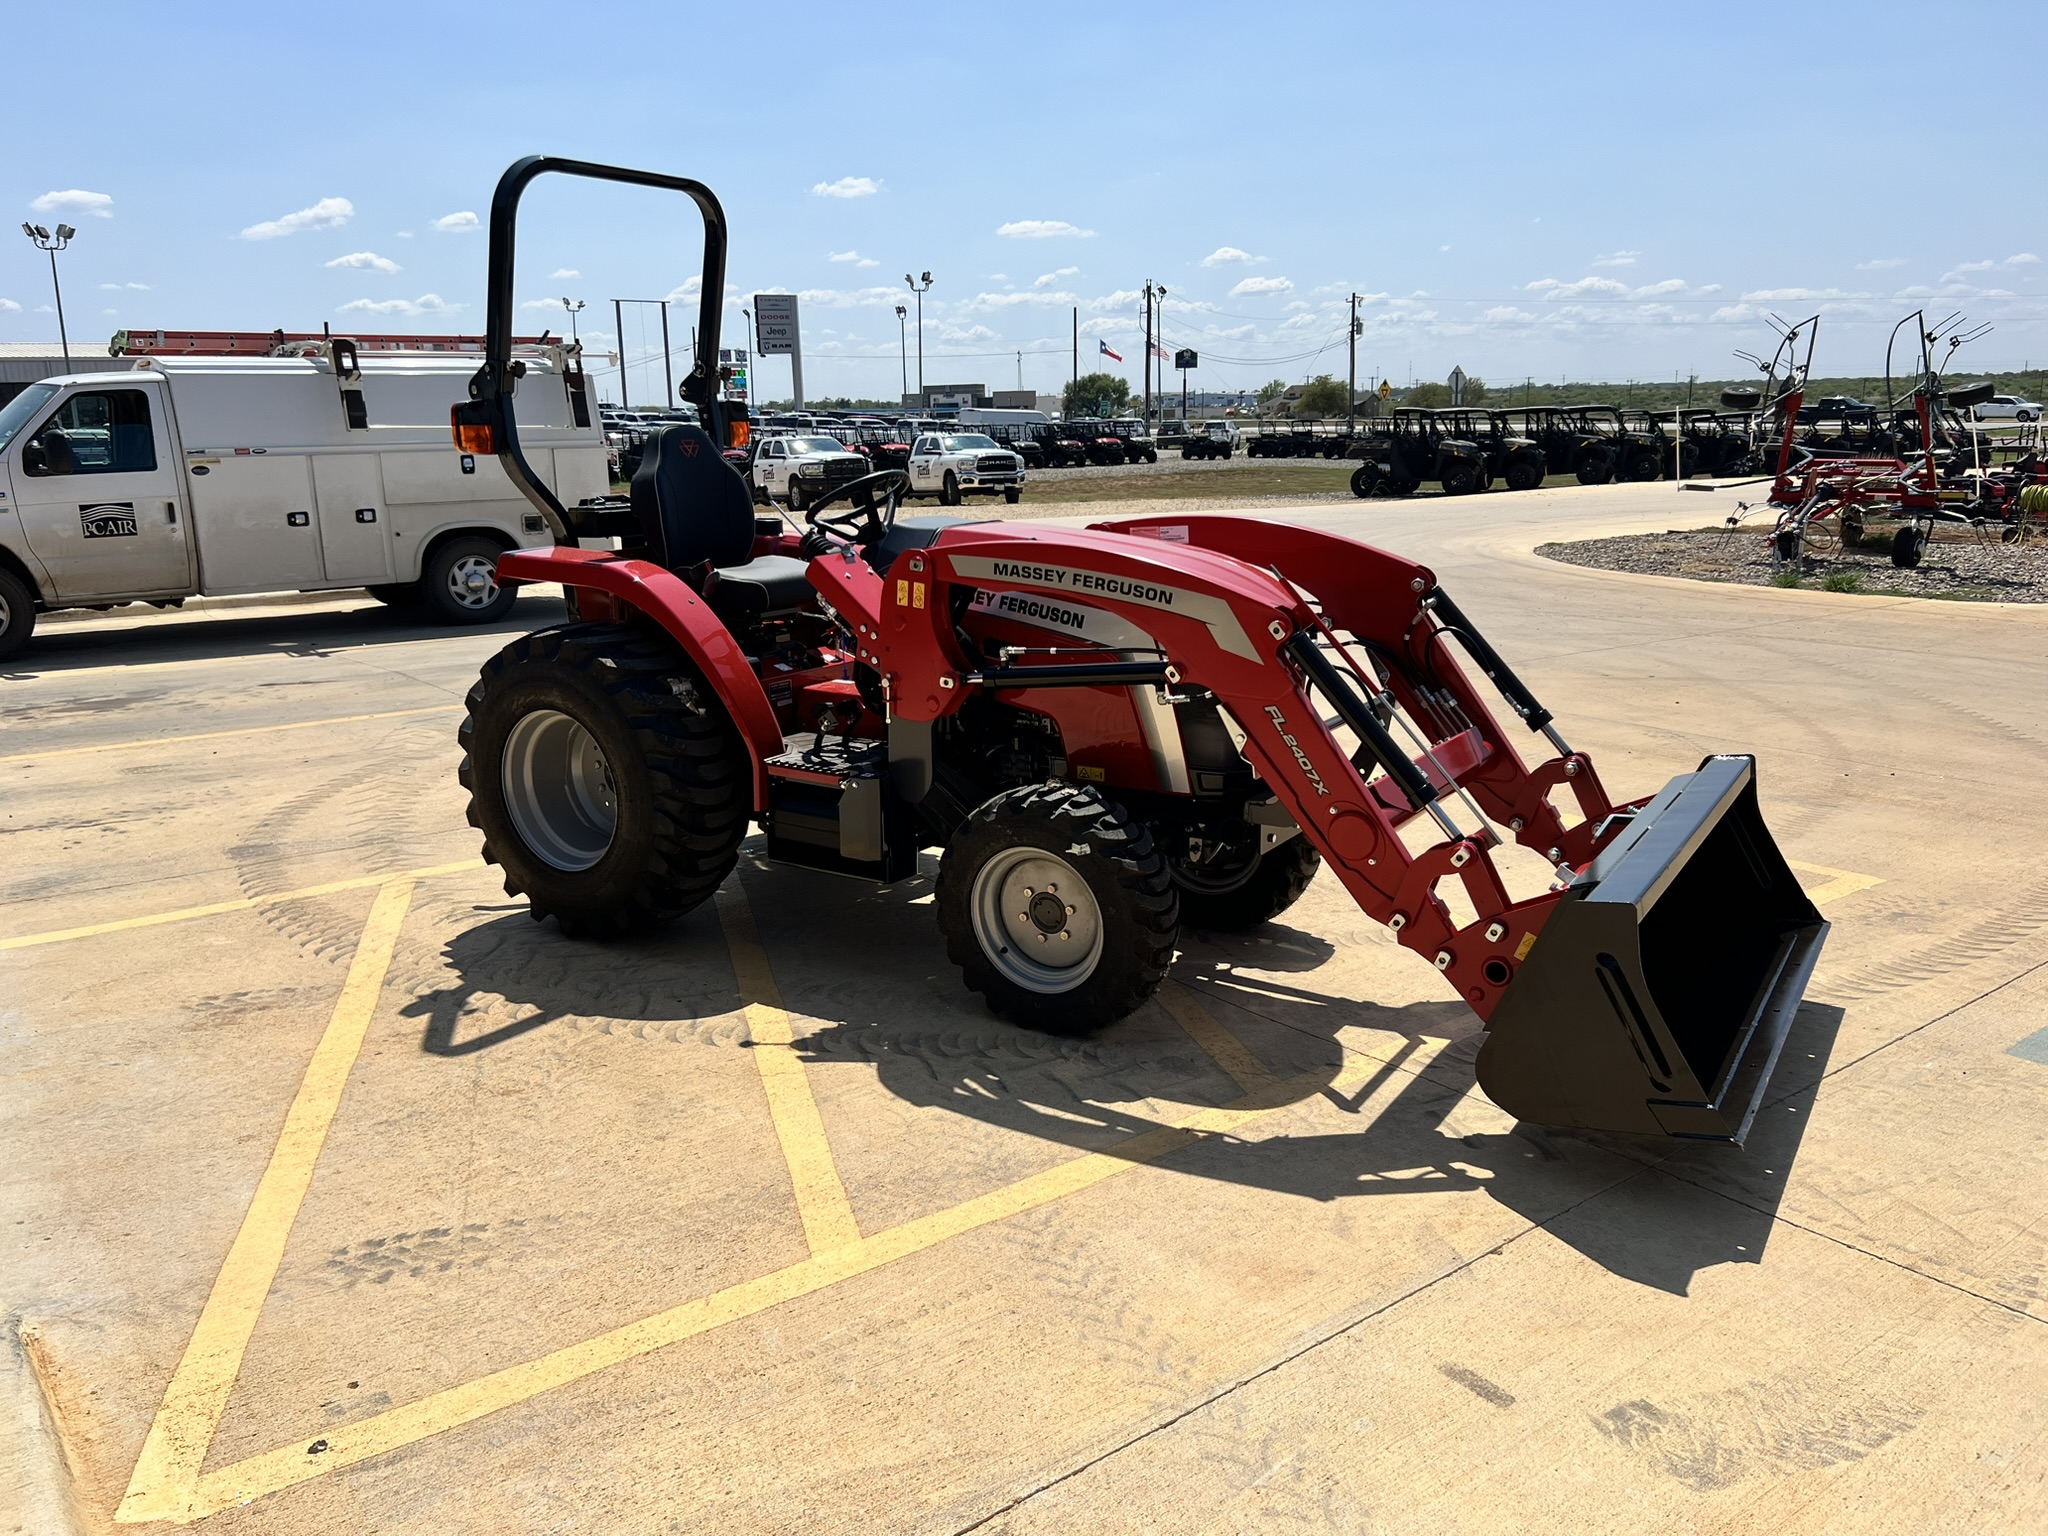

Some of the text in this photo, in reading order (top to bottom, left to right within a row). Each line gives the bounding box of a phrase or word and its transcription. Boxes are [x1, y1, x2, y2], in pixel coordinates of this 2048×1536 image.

[766, 326, 787, 336] Jeep
[993, 562, 1174, 605] MASSEY FERGUSON
[970, 590, 1086, 629] EY FERGUSON
[1264, 705, 1330, 796] FL.2407X
